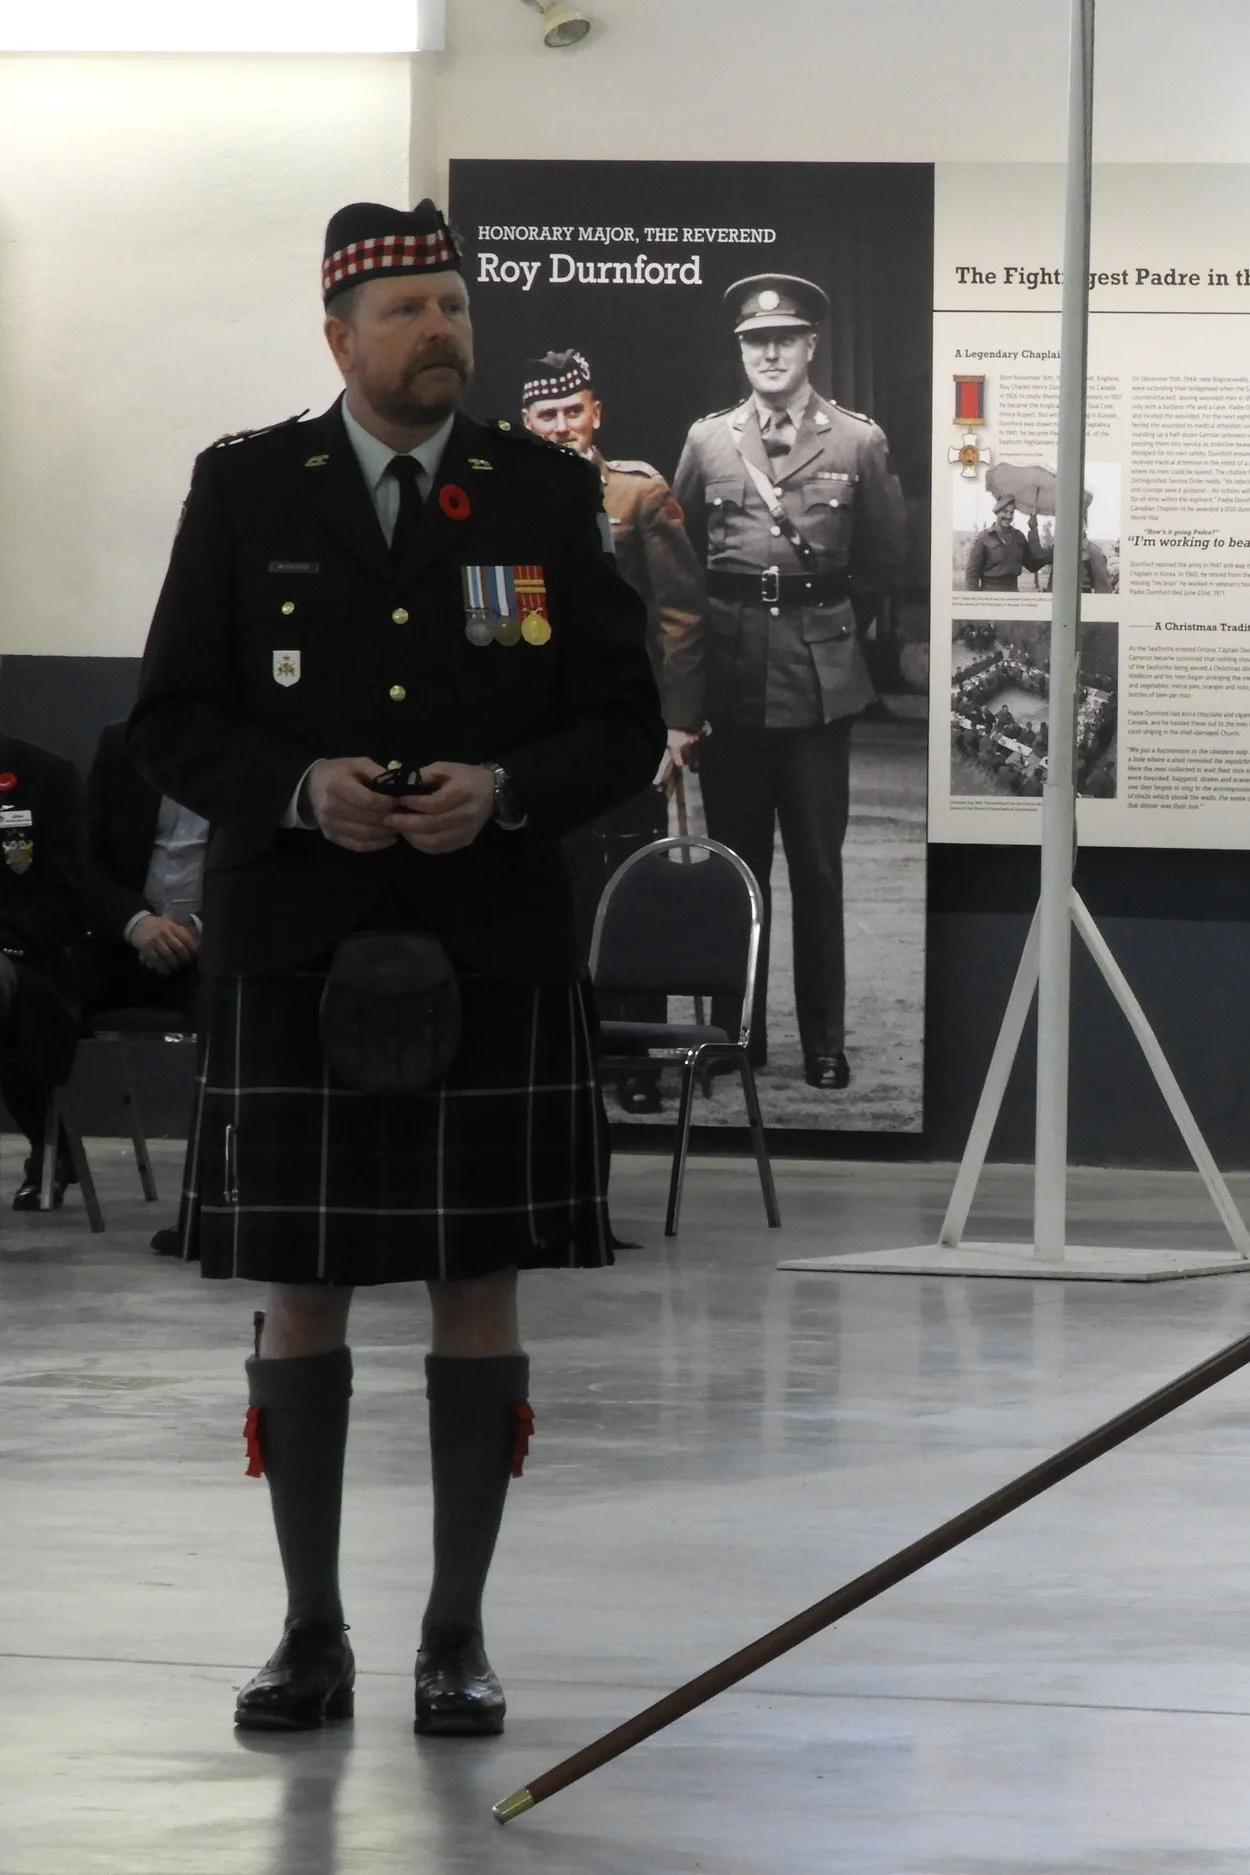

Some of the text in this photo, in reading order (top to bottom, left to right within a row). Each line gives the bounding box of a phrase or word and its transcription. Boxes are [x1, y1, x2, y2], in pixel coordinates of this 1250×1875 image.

[478, 226, 776, 245] HONORARY MAJOR, THE REVEREND
[477, 253, 702, 291] Roy Durnford
[955, 266, 996, 284] The
[1004, 267, 1129, 291] Fightgest
[1135, 268, 1200, 286] Padre
[1207, 268, 1229, 286] in
[955, 349, 1061, 361] A Legendary Chaplai
[1159, 536, 1210, 550] working
[1214, 538, 1225, 547] to
[1154, 622, 1162, 631] A
[1164, 622, 1218, 632] Christmas
